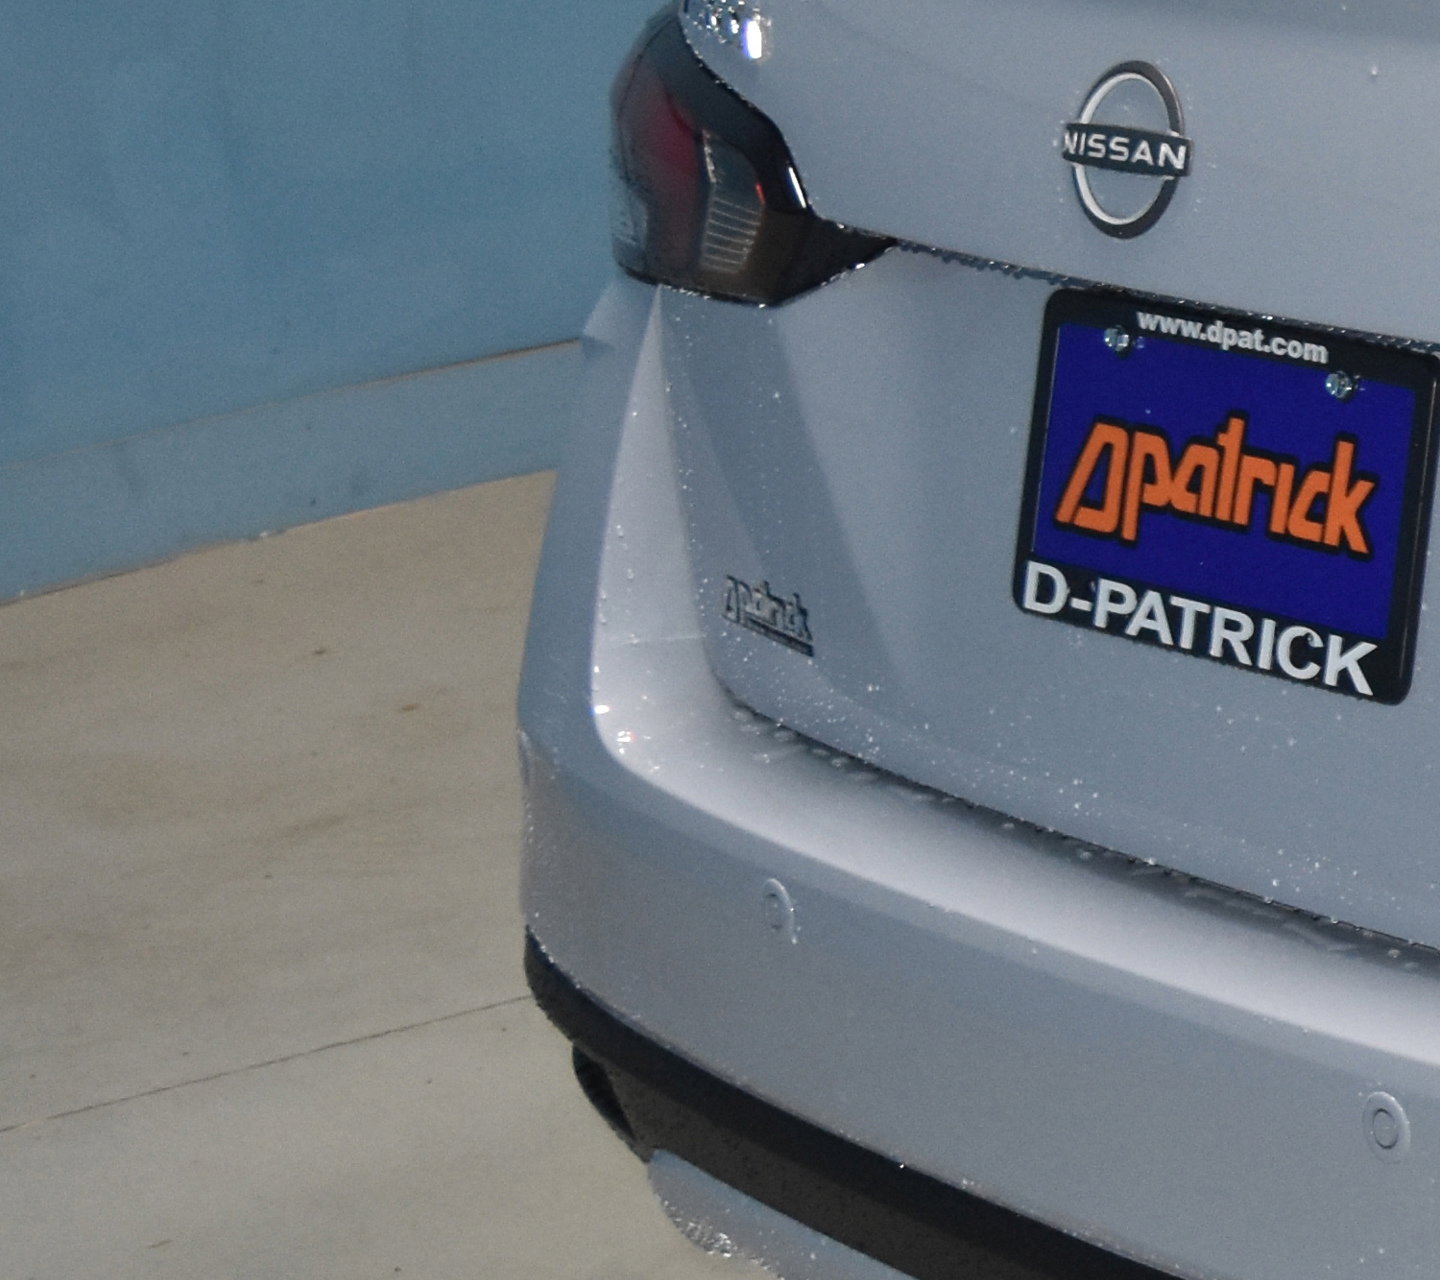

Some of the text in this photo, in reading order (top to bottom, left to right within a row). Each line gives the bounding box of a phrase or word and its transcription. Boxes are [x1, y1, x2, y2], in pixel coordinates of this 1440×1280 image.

[1064, 131, 1187, 170] NISSAN
[1135, 311, 1329, 364] www.dpat.com
[1022, 560, 1379, 696] D-PATRICK
